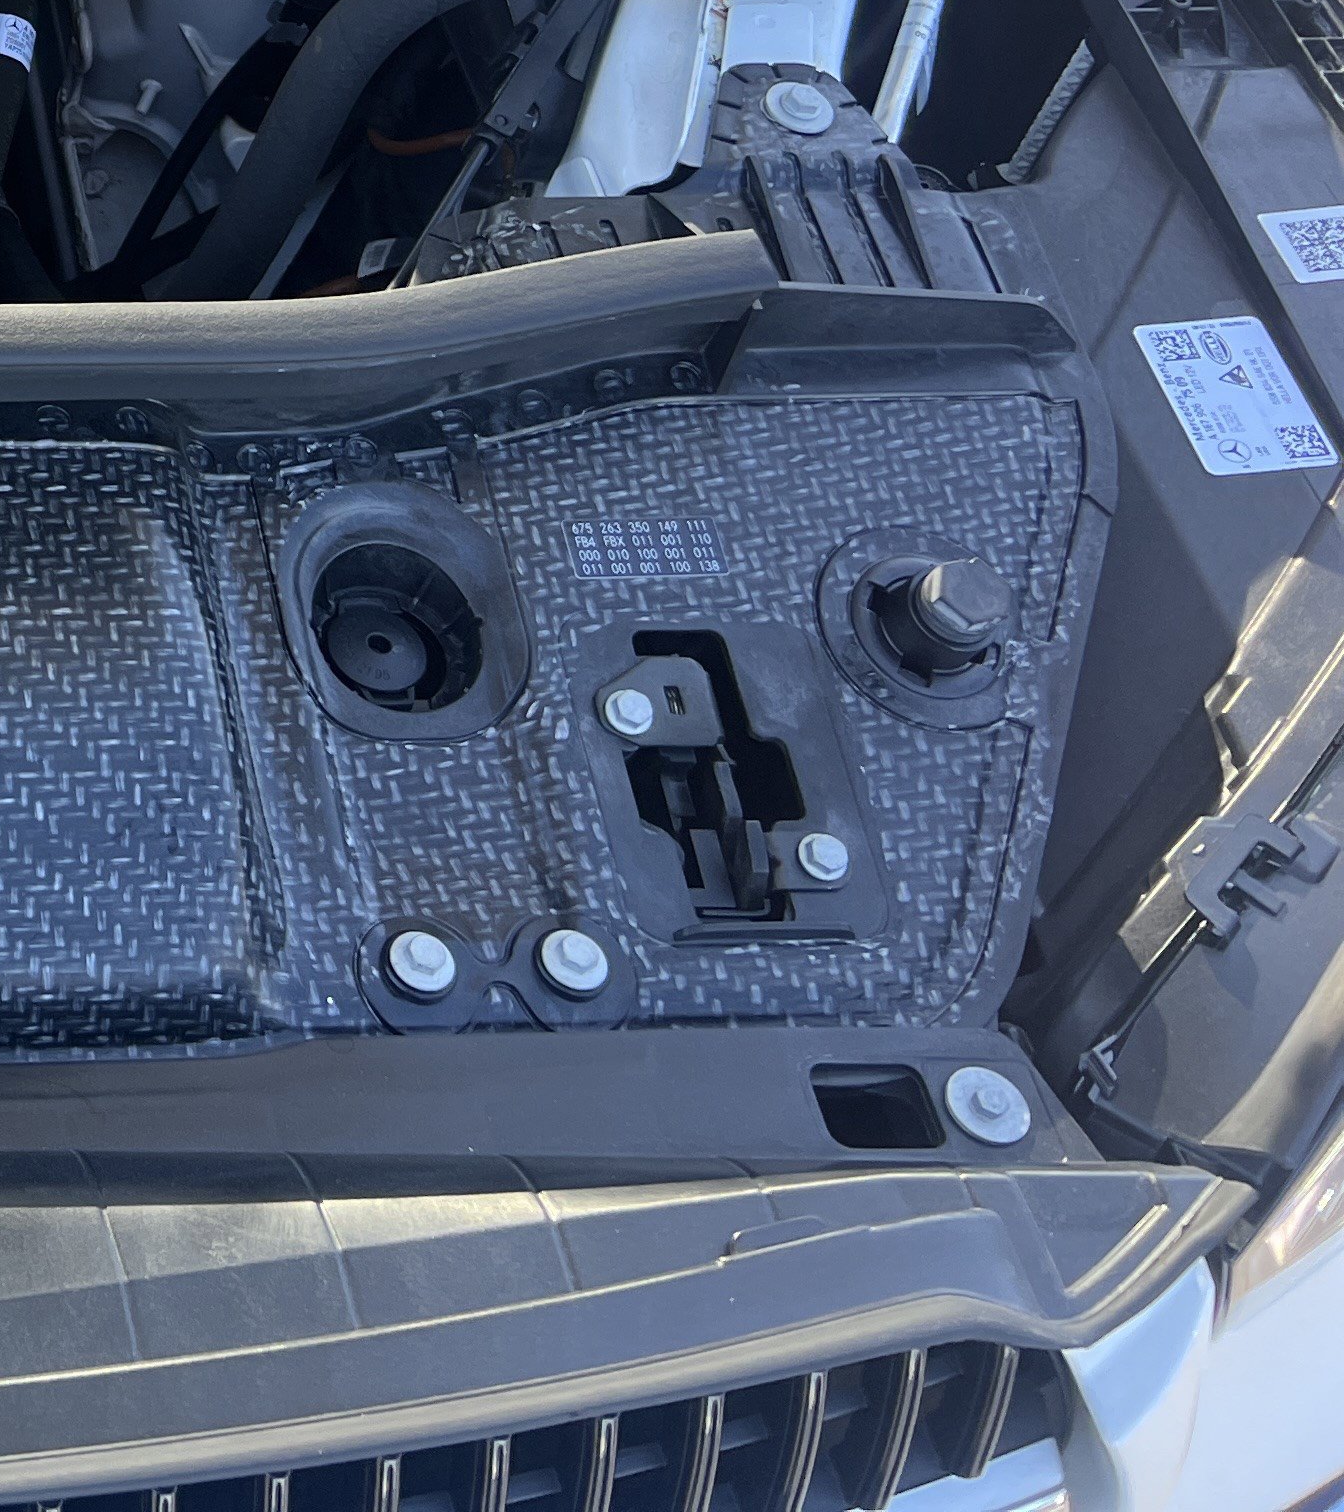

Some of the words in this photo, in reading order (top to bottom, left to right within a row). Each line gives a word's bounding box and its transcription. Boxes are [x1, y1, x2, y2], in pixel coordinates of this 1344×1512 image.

[572, 523, 593, 534] 675
[600, 523, 621, 533] 263
[628, 522, 649, 533] 350
[658, 521, 677, 532] 149
[687, 520, 706, 531] 111
[575, 537, 595, 547] FB4
[603, 536, 625, 546] FBX
[632, 535, 653, 546] 011
[661, 535, 682, 545] 001
[691, 533, 711, 544] 110
[579, 550, 600, 561] 000
[608, 550, 629, 560] 010
[637, 549, 658, 559] 100
[665, 548, 686, 559] 001
[693, 547, 714, 557] 011
[583, 564, 604, 575] 011
[611, 563, 632, 574] 001
[640, 562, 661, 573] 001
[670, 561, 690, 572] 100
[699, 560, 720, 571] 138
